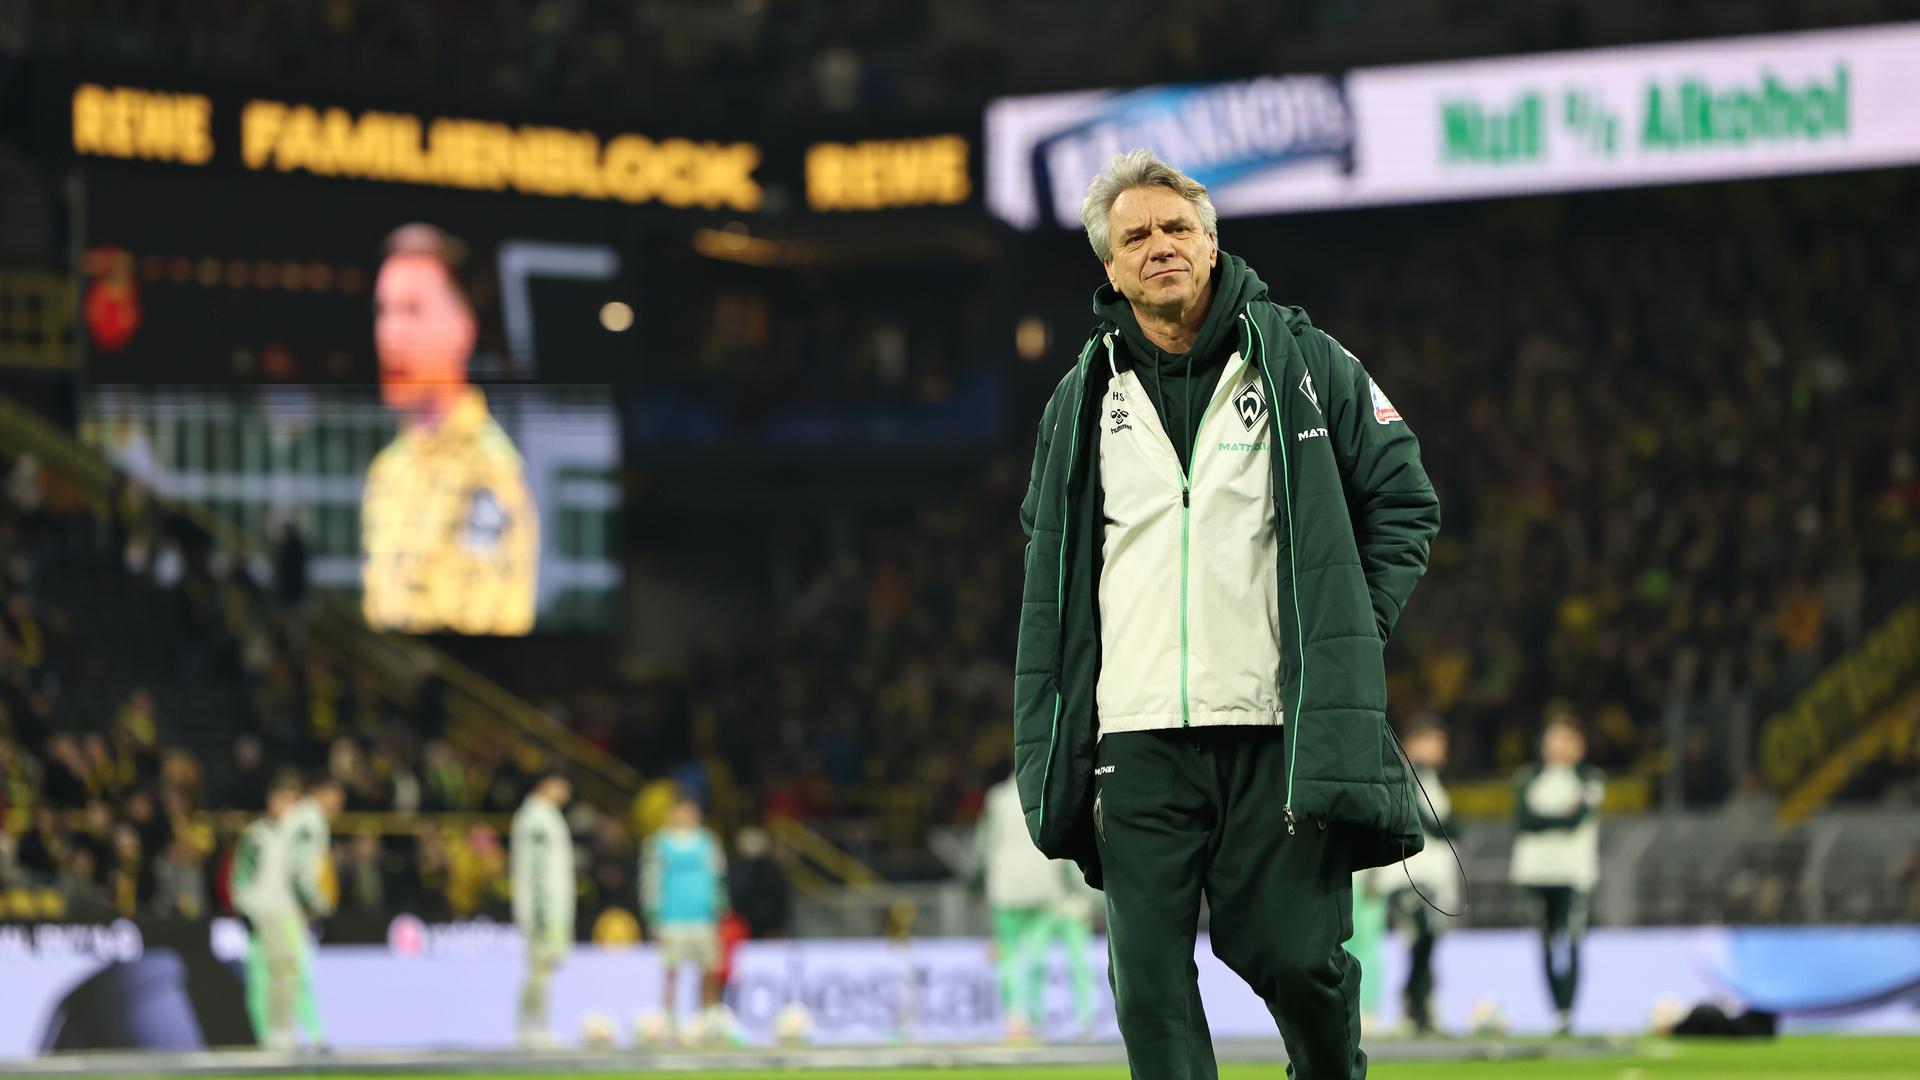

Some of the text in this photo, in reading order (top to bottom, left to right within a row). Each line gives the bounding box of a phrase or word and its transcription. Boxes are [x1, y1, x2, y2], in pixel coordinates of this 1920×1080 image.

[1640, 63, 1850, 149] Alkohol
[73, 85, 213, 165] REWE
[242, 101, 762, 210] FAMILIENBLOCK
[805, 134, 971, 211] REWE
[1112, 391, 1125, 402] HS
[1297, 427, 1328, 441] MATT
